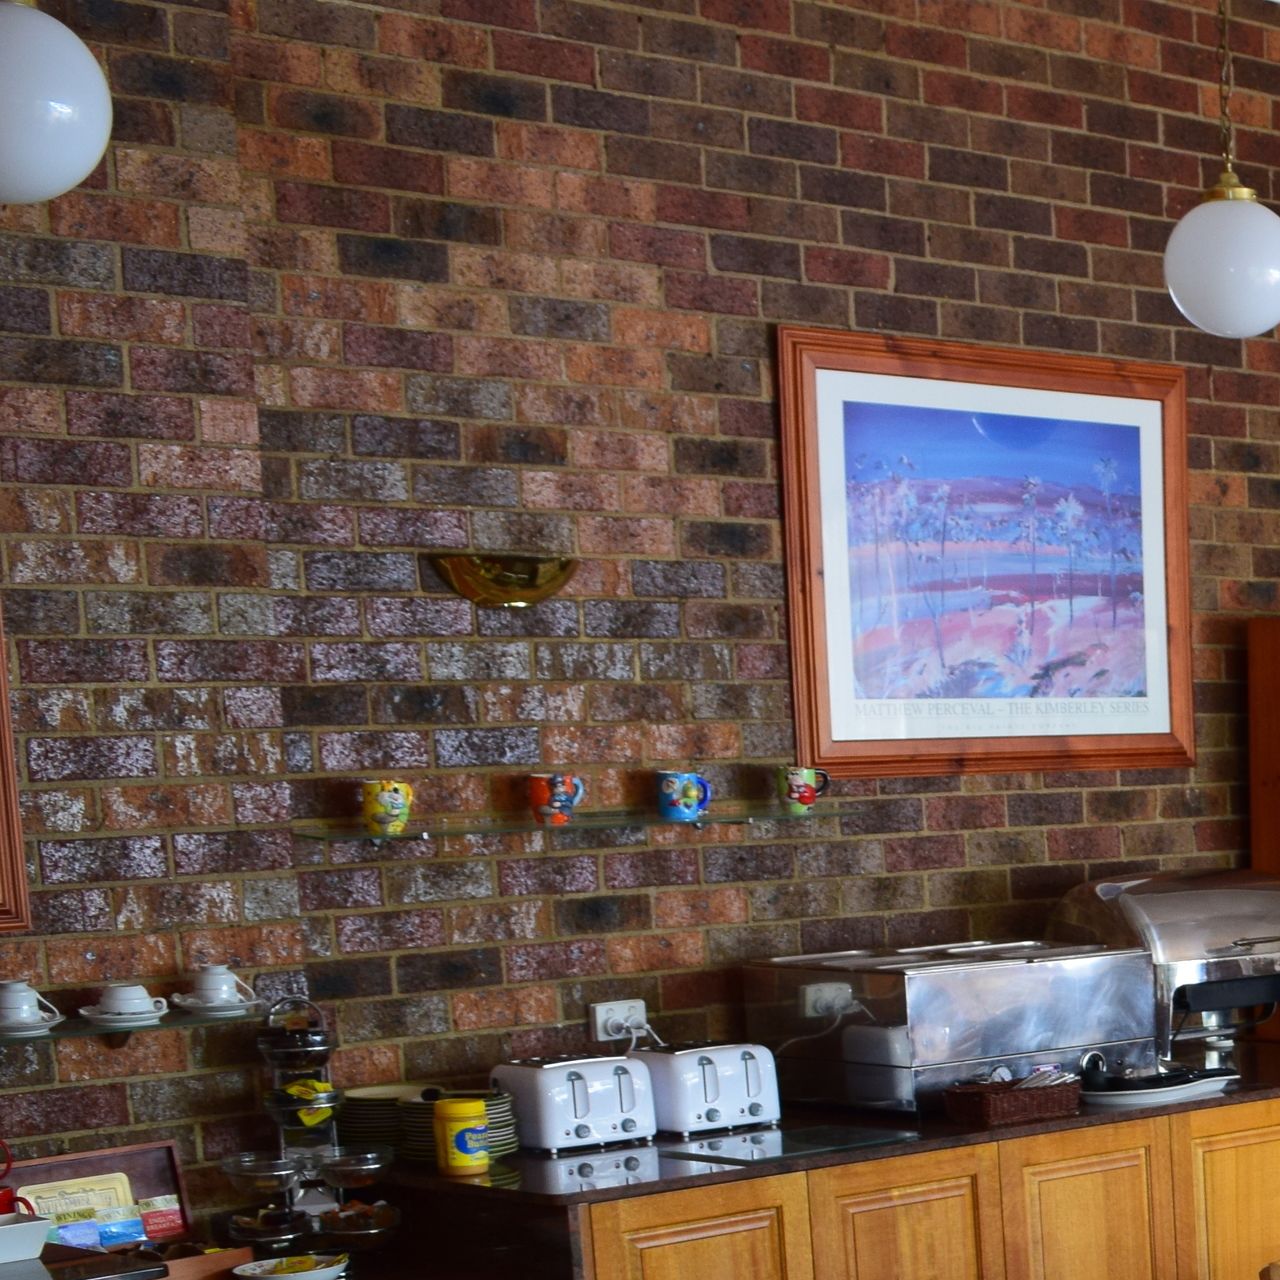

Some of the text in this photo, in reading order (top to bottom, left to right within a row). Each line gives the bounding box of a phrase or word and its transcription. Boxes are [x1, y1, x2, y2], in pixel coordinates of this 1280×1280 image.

[928, 702, 994, 717] PERCEVAL
[1008, 702, 1032, 715] THE
[1035, 701, 1105, 715] KIMBERLEY
[1109, 701, 1150, 714] SERIES
